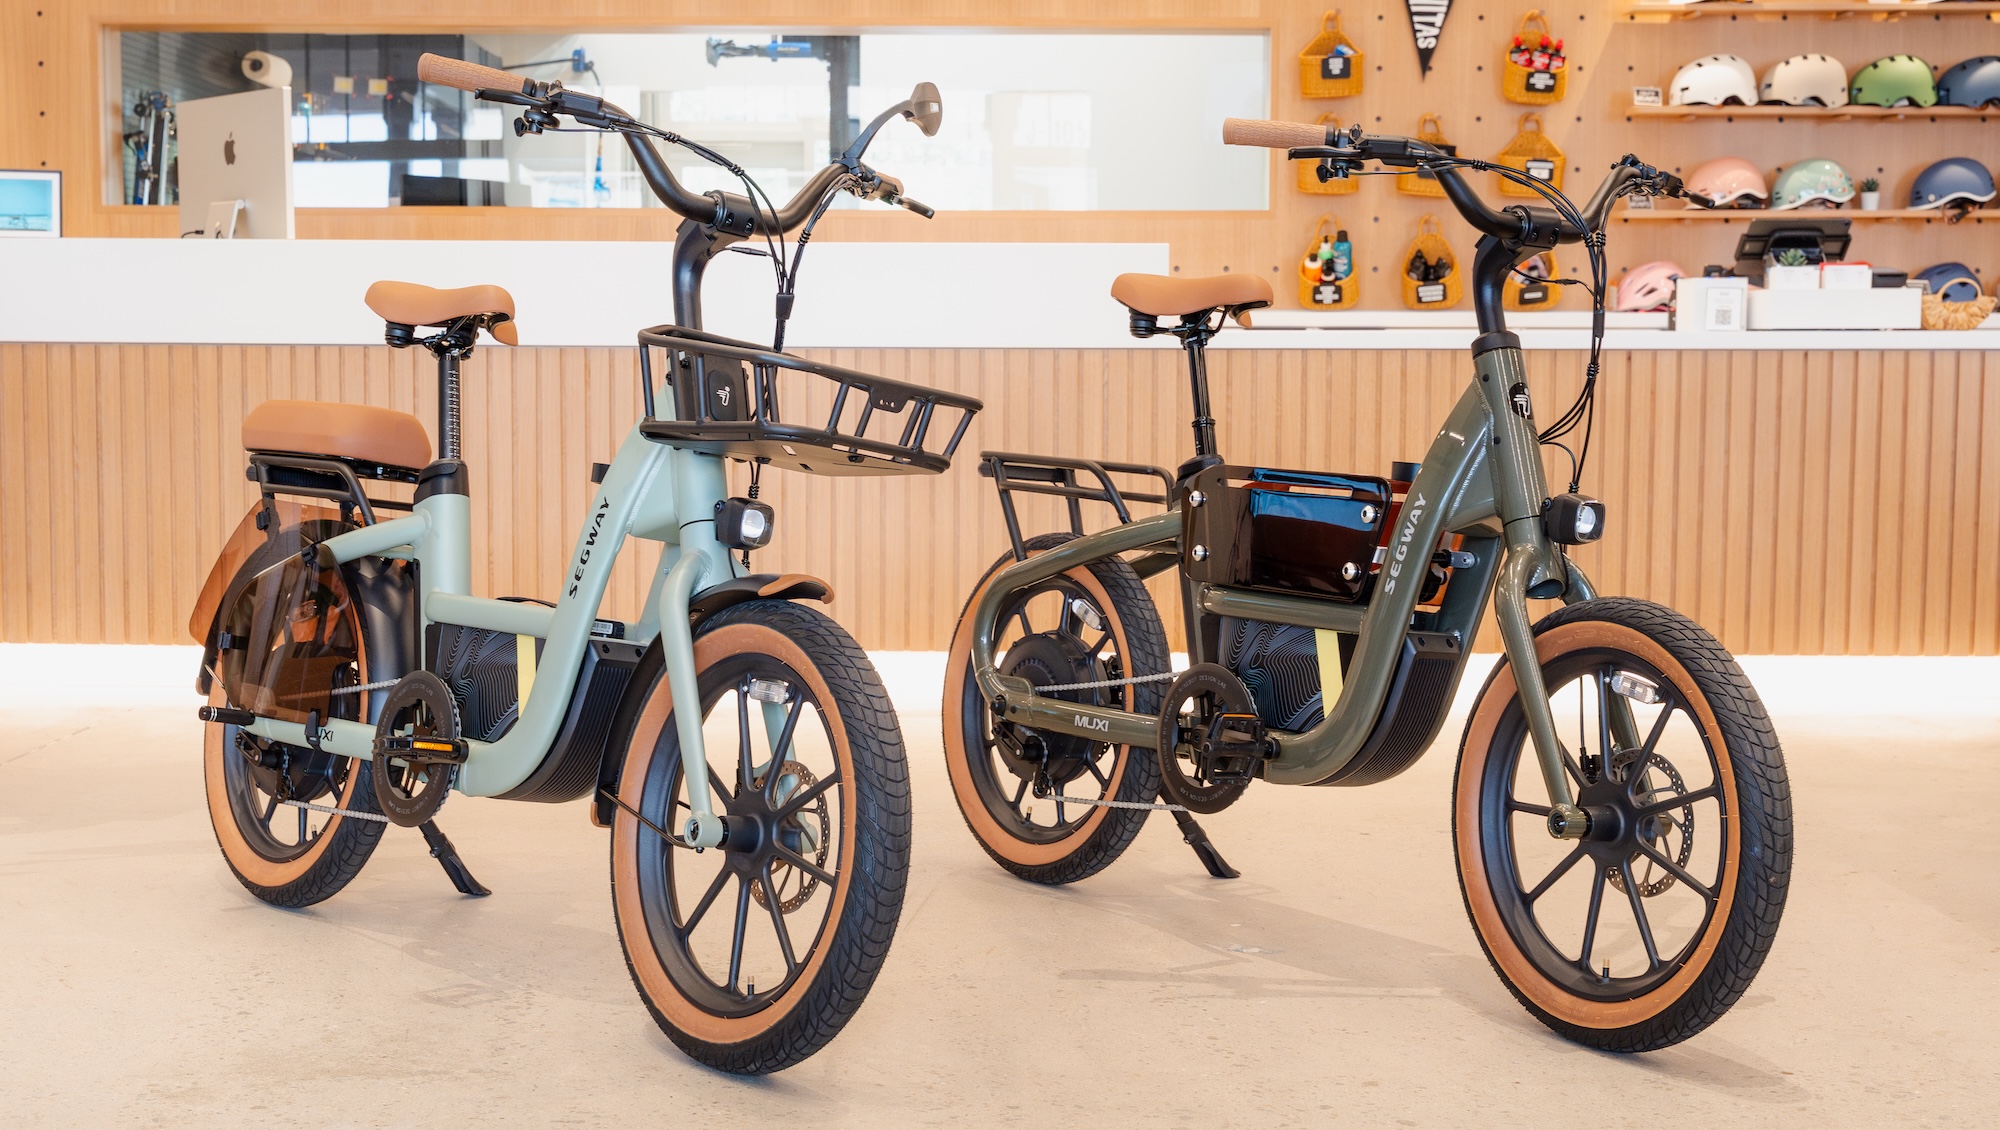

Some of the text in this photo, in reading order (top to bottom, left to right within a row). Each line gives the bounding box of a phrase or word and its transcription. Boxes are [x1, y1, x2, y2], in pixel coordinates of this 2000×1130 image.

[569, 496, 610, 599] SEGWAY
[1385, 493, 1427, 595] SEGWAY
[1074, 714, 1109, 732] MUXI
